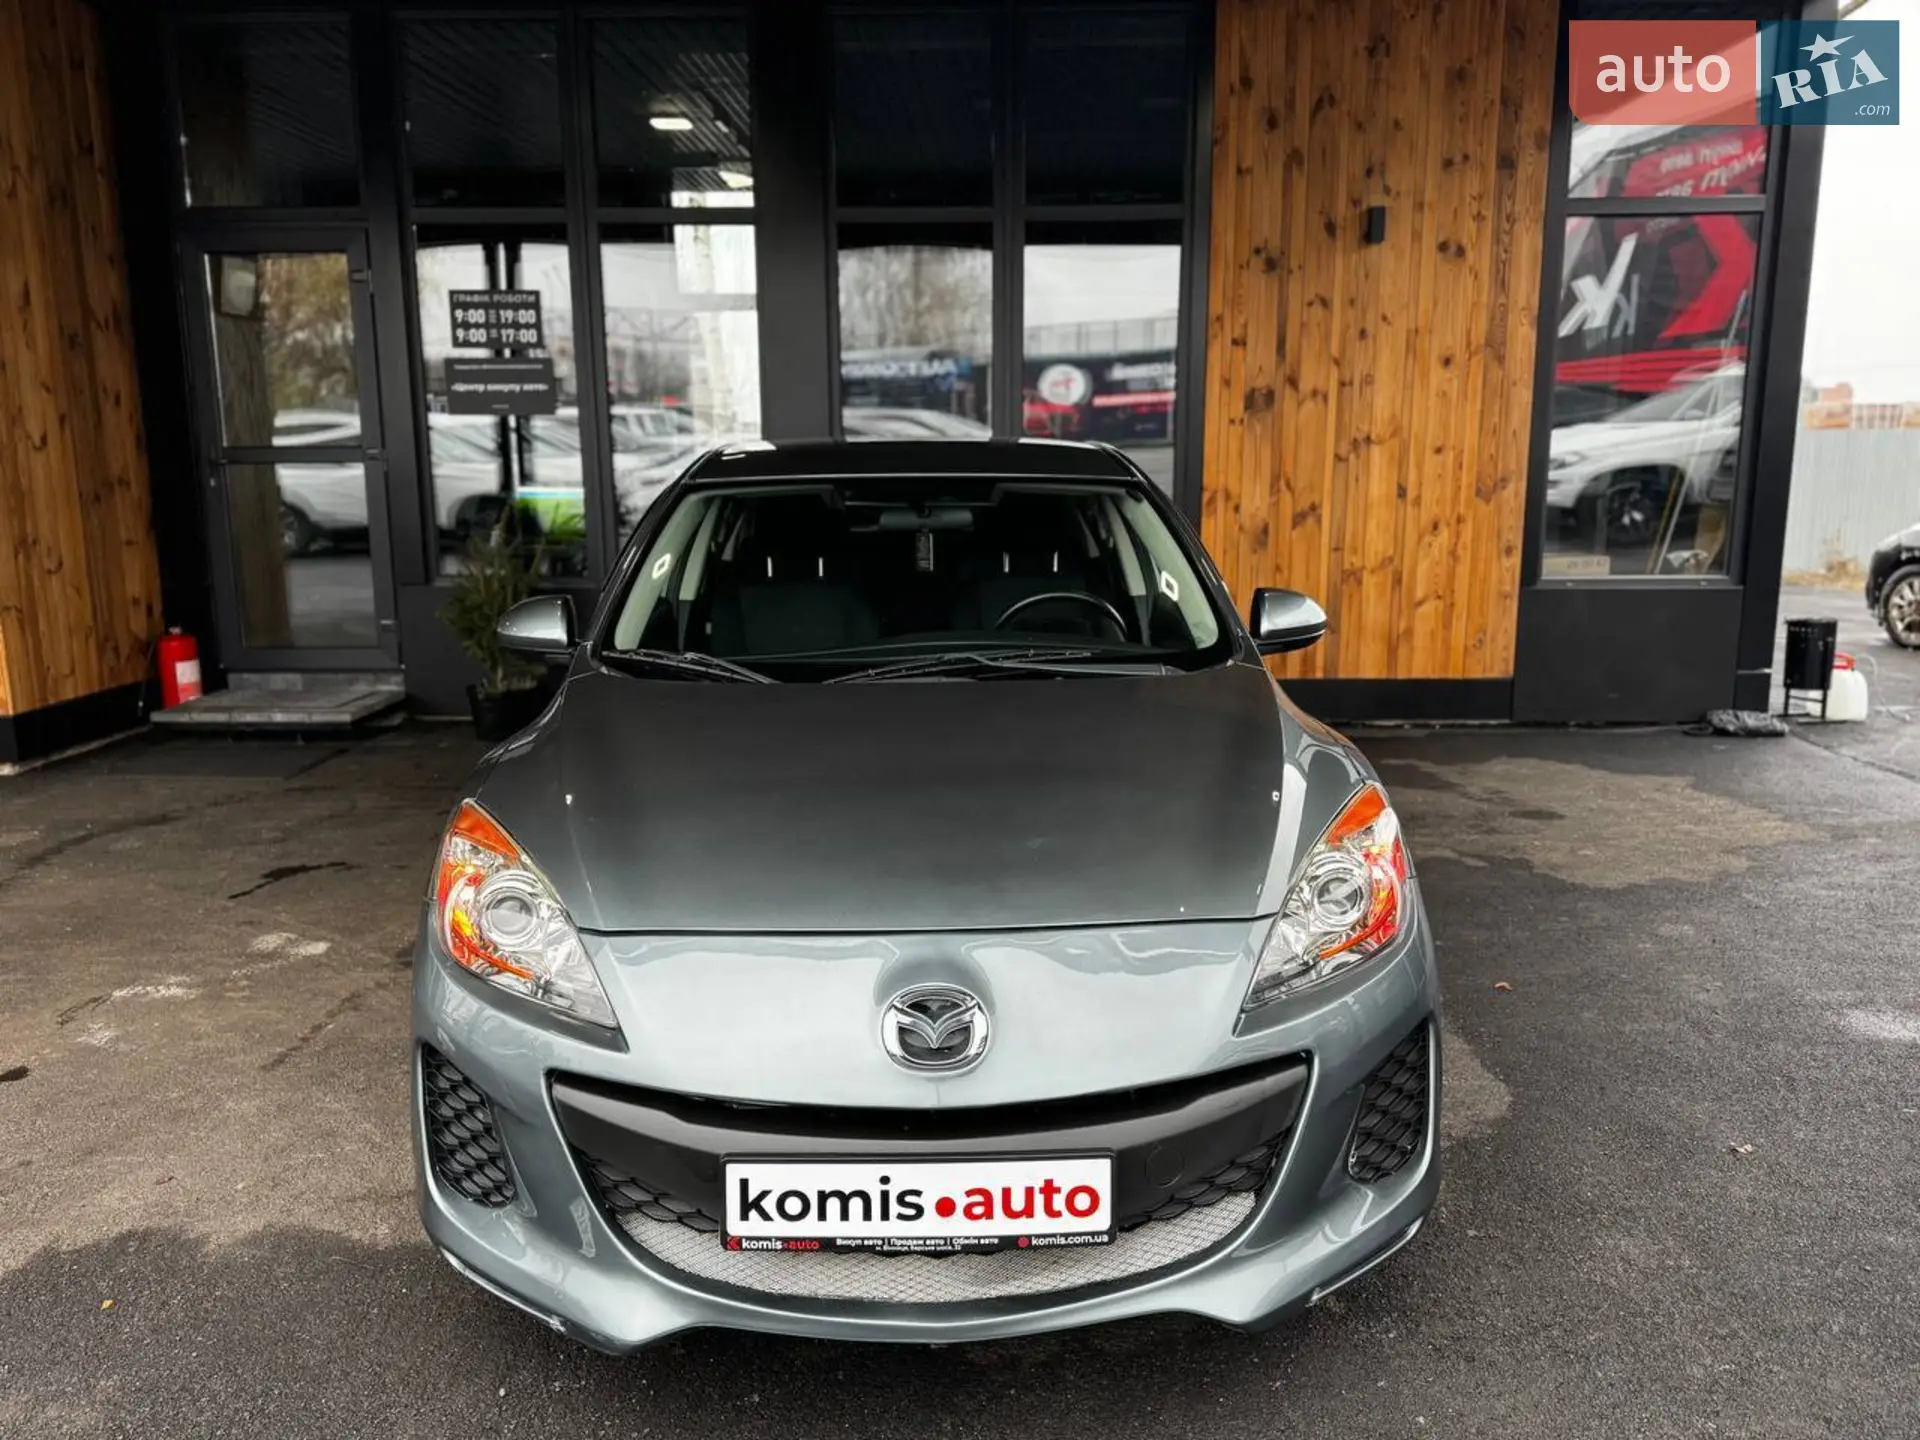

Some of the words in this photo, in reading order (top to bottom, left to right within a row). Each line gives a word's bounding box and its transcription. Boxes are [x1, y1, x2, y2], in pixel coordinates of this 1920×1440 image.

[454, 308, 486, 324] 9:00
[499, 308, 537, 324] 19:00
[455, 328, 487, 343] 9:00
[500, 328, 538, 343] 17:00
[1031, 1234, 1109, 1246] komis.com.ua
